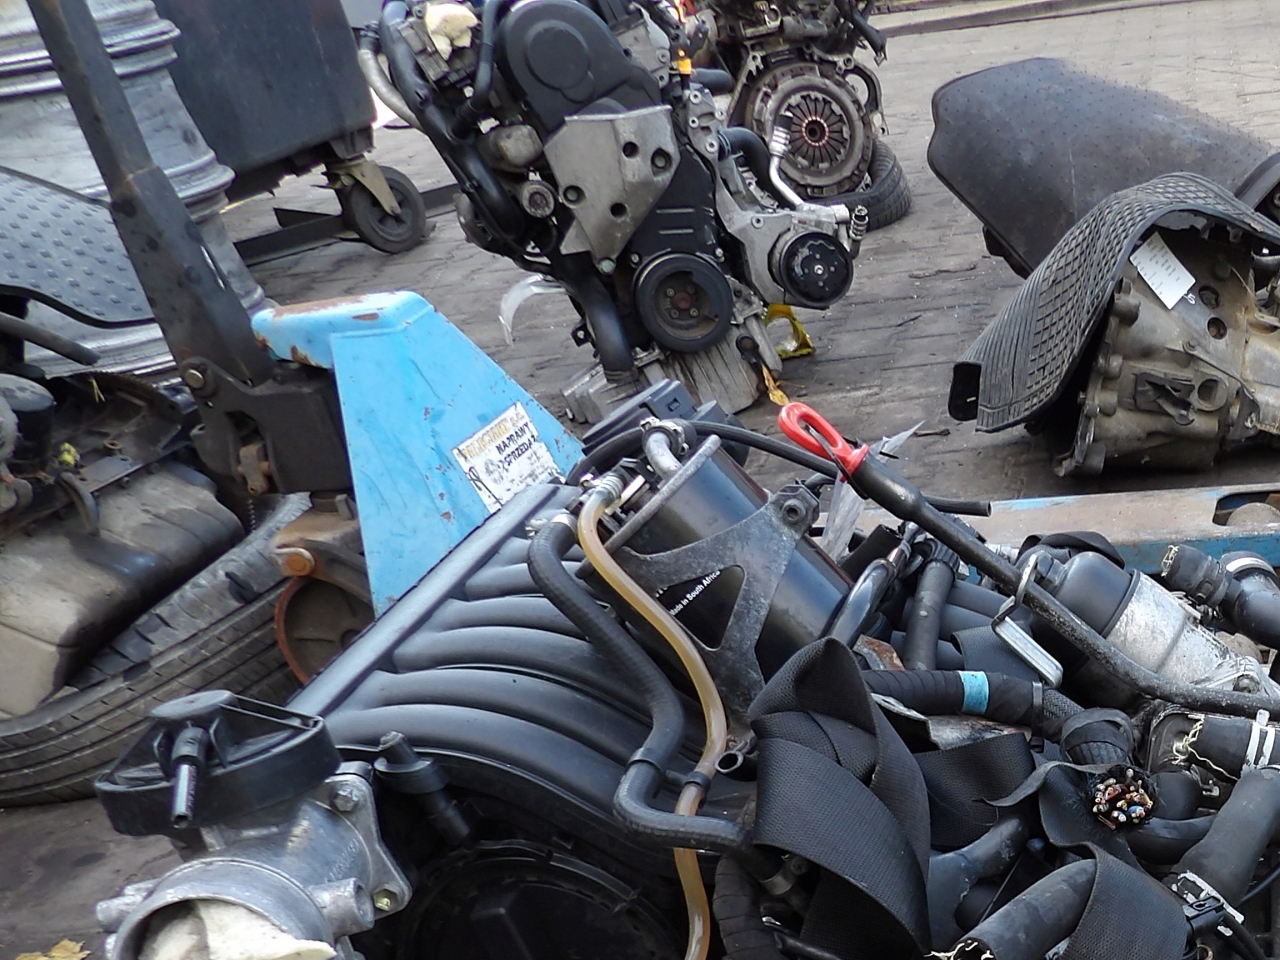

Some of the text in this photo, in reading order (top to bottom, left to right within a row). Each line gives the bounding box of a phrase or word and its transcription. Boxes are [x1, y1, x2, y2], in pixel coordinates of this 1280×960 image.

[495, 421, 531, 455] NAPRAWY
[685, 584, 705, 601] South
[701, 570, 721, 587] Africa
